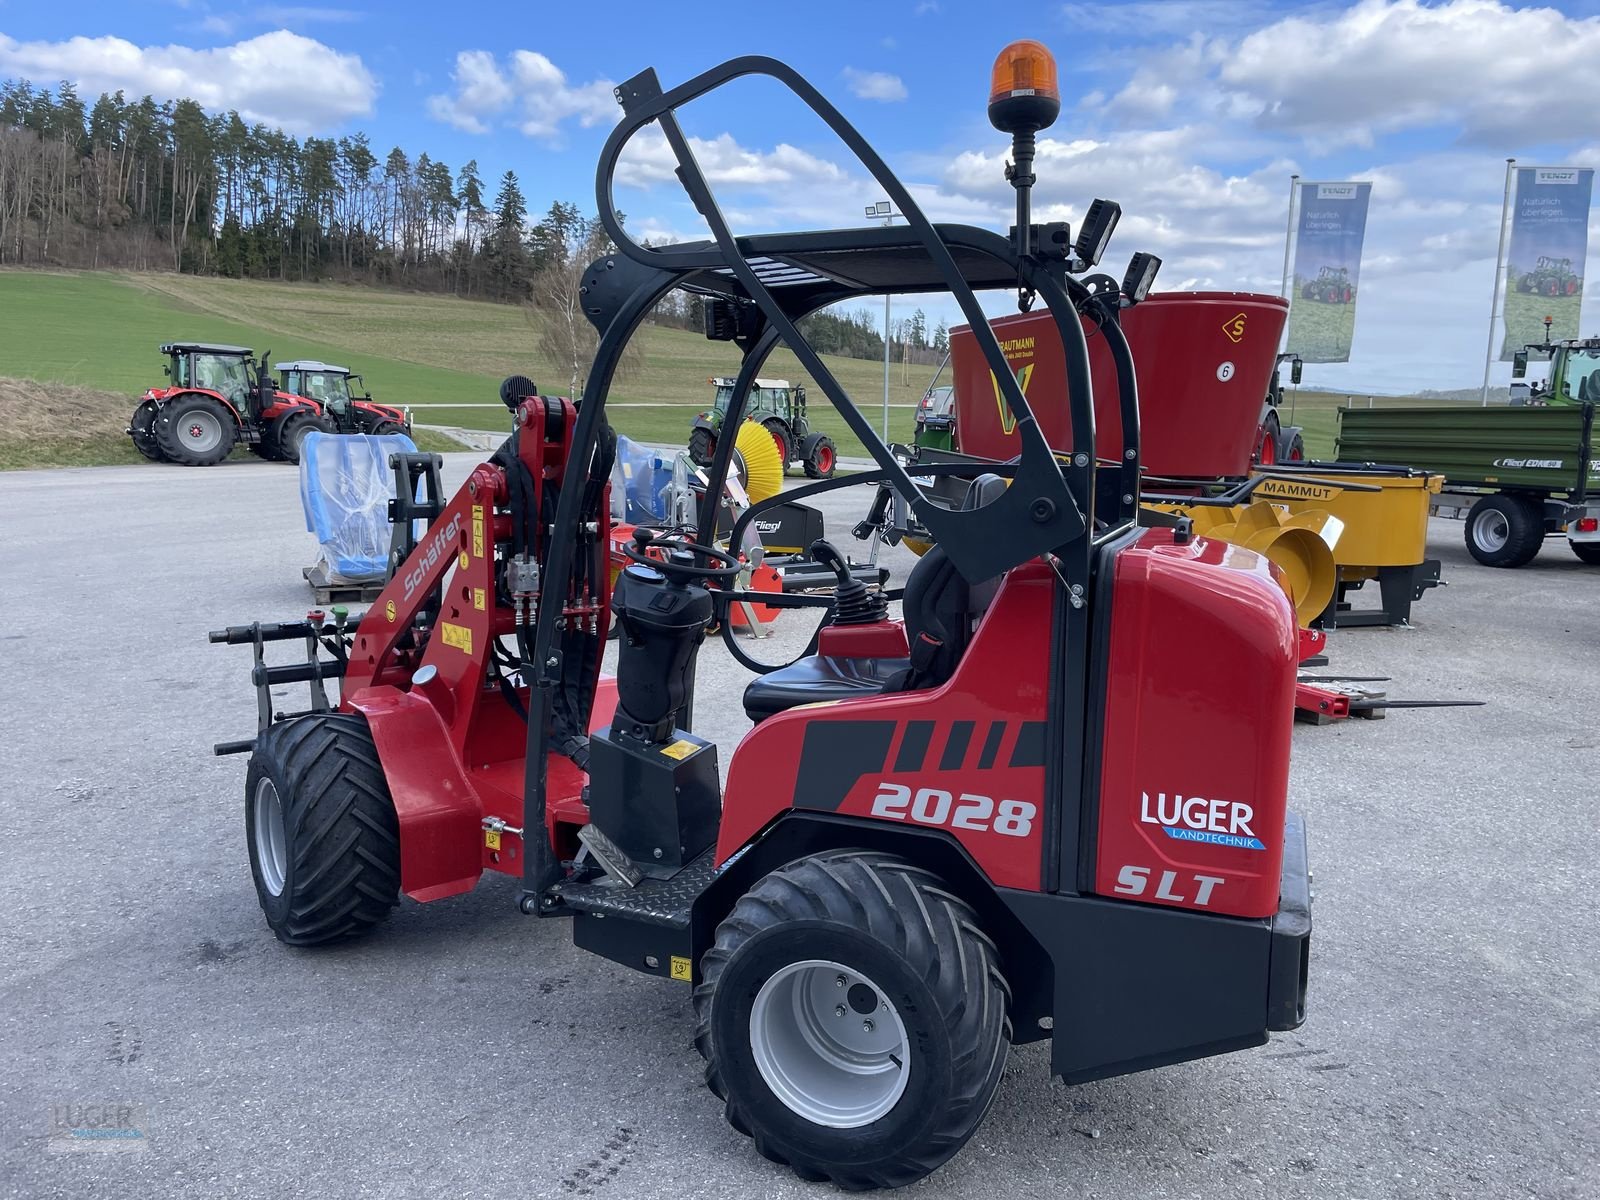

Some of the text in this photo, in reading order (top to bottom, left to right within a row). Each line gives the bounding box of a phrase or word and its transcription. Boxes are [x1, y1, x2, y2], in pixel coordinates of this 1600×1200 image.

[999, 337, 1034, 351] RAUTMANN
[1222, 365, 1230, 378] 6
[1264, 482, 1331, 499] MAMMUT
[755, 520, 782, 531] Fliegl
[404, 512, 462, 602] Schäffer
[871, 782, 1037, 837] 2028
[1141, 791, 1256, 837] LUGER
[1172, 828, 1255, 848] LANDTECHNIK
